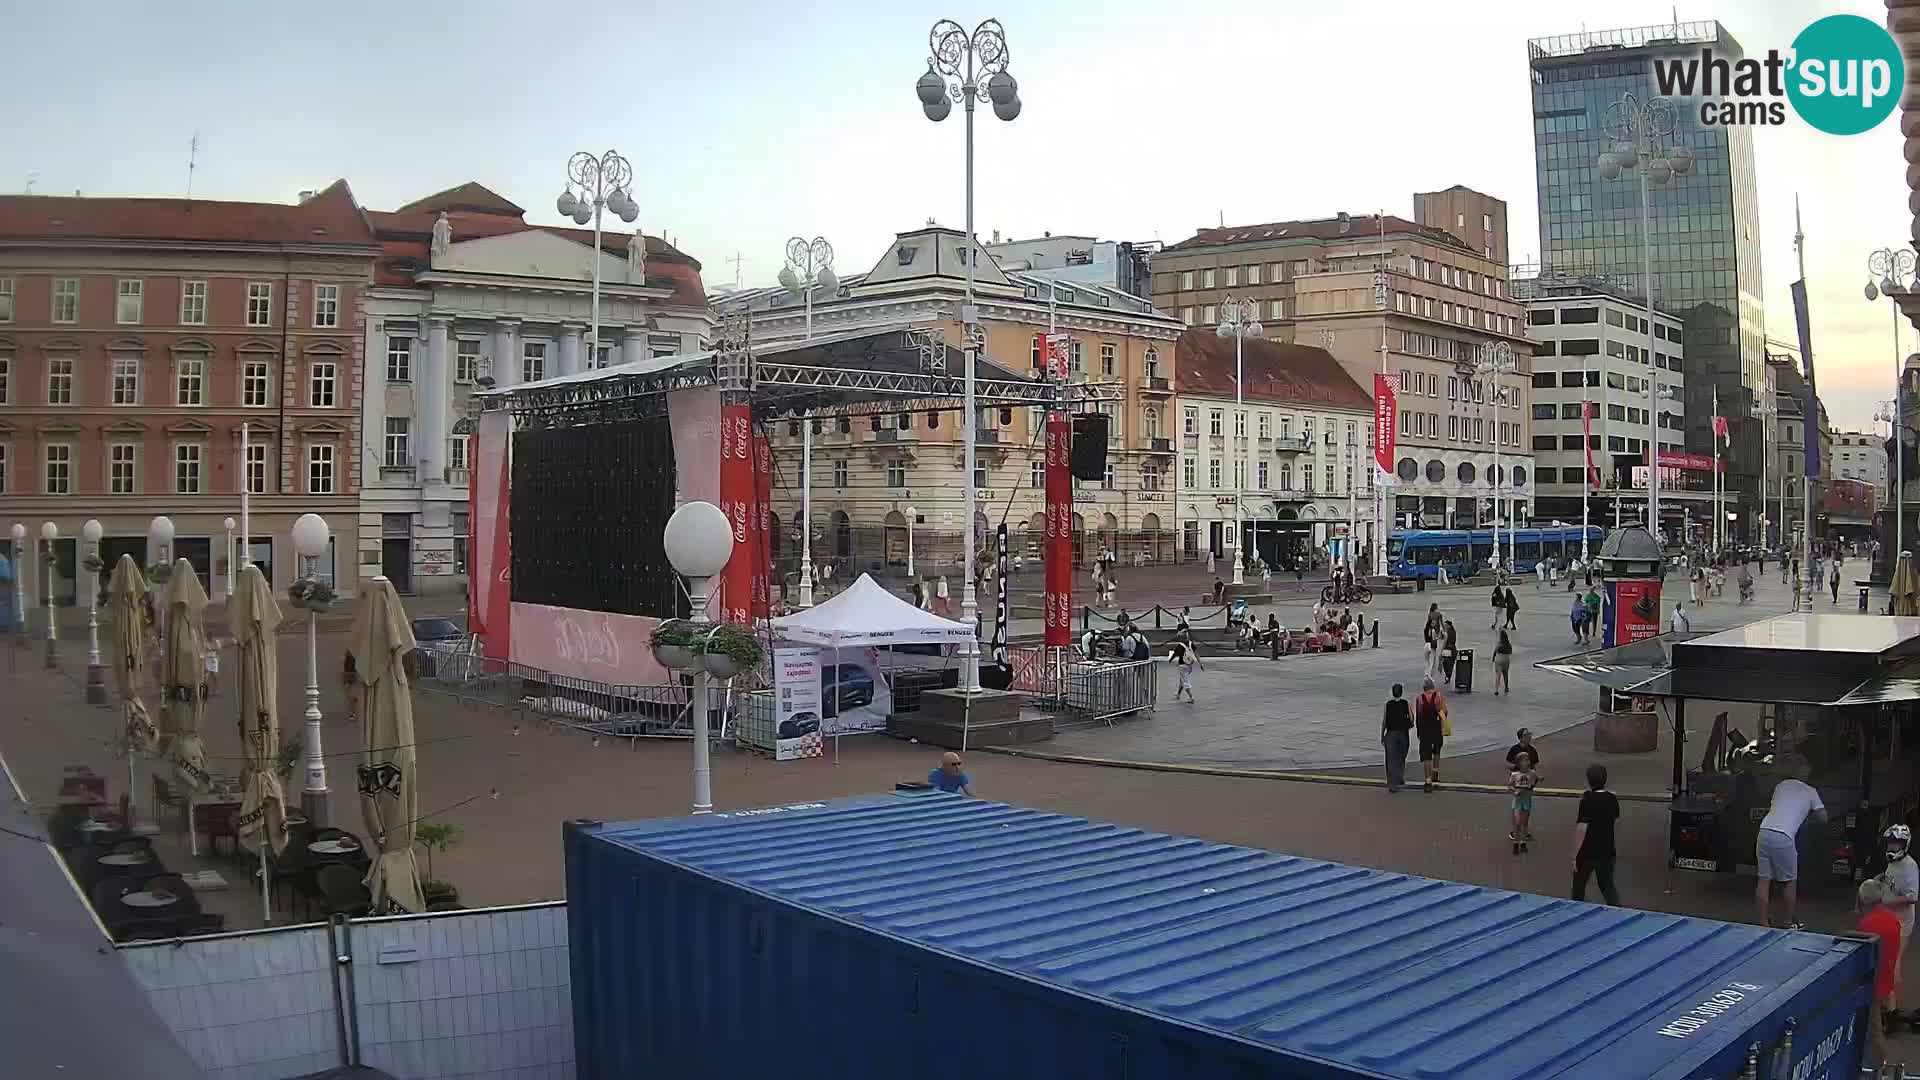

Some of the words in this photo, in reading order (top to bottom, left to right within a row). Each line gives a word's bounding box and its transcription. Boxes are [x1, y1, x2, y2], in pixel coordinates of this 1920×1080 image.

[735, 416, 749, 459] Coca-Cola
[734, 501, 748, 543] Coca-Cola
[1656, 1015, 1708, 1039] MCDU
[1689, 988, 1746, 1018] 300629
